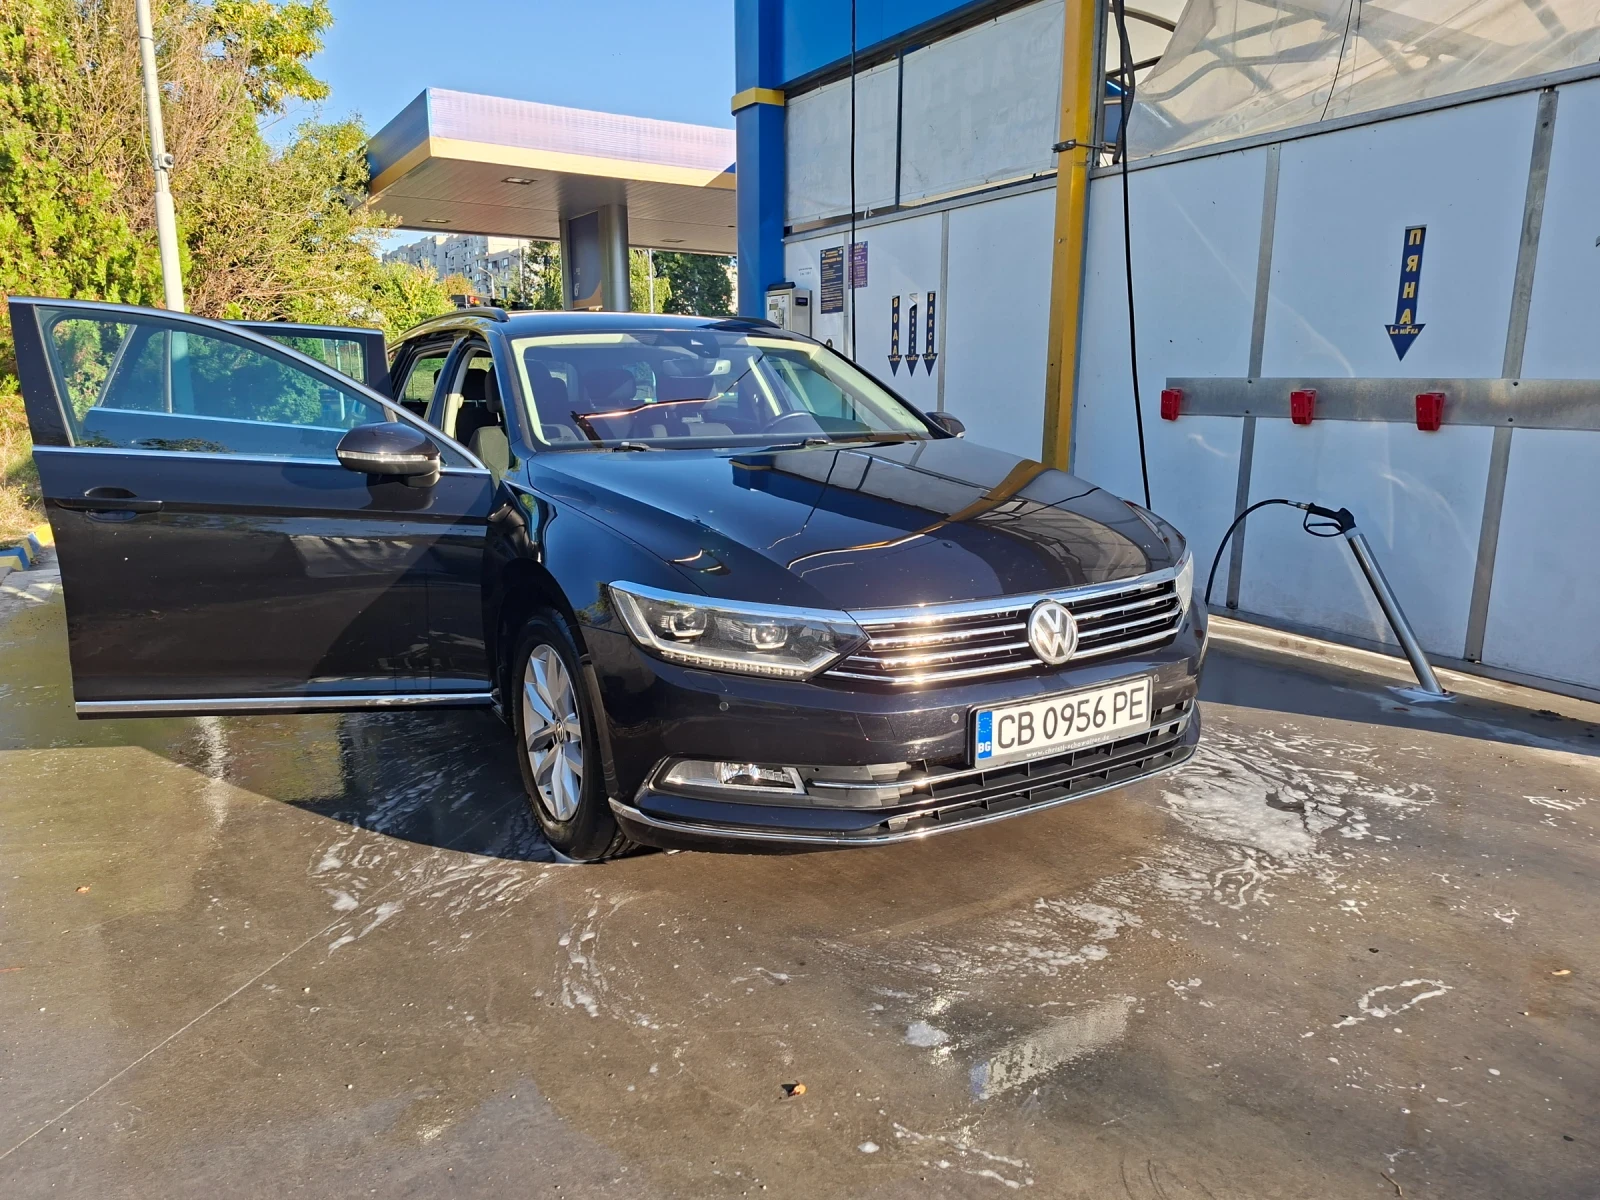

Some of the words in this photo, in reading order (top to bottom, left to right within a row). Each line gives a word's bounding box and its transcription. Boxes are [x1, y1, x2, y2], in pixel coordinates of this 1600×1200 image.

[1399, 229, 1422, 325] ПЯНА
[978, 741, 992, 754] BG
[998, 711, 1035, 749] CB
[1043, 696, 1106, 739] 0956
[1112, 686, 1145, 724] PE
